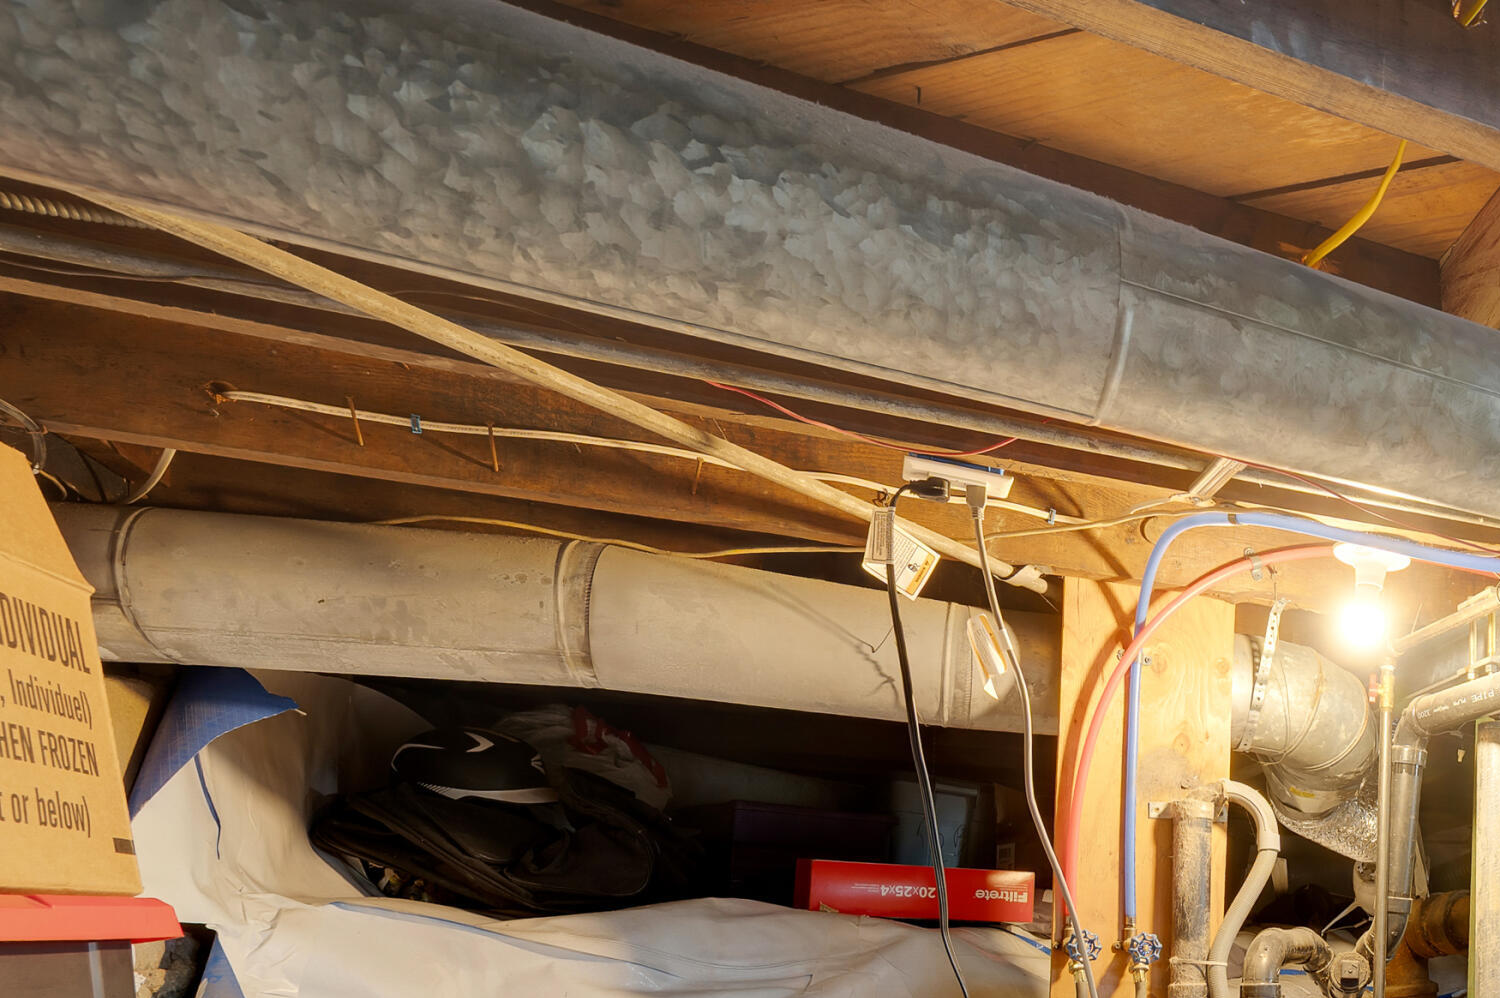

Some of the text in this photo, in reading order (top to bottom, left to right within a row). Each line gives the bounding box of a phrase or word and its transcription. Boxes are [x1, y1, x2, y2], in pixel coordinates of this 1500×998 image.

[0, 592, 90, 674] DIVIDUAL
[8, 668, 92, 730] Individuel)
[38, 730, 100, 777] FROZEN
[11, 787, 91, 838] or below)
[880, 885, 1028, 903] Filtrete 20x25x4
